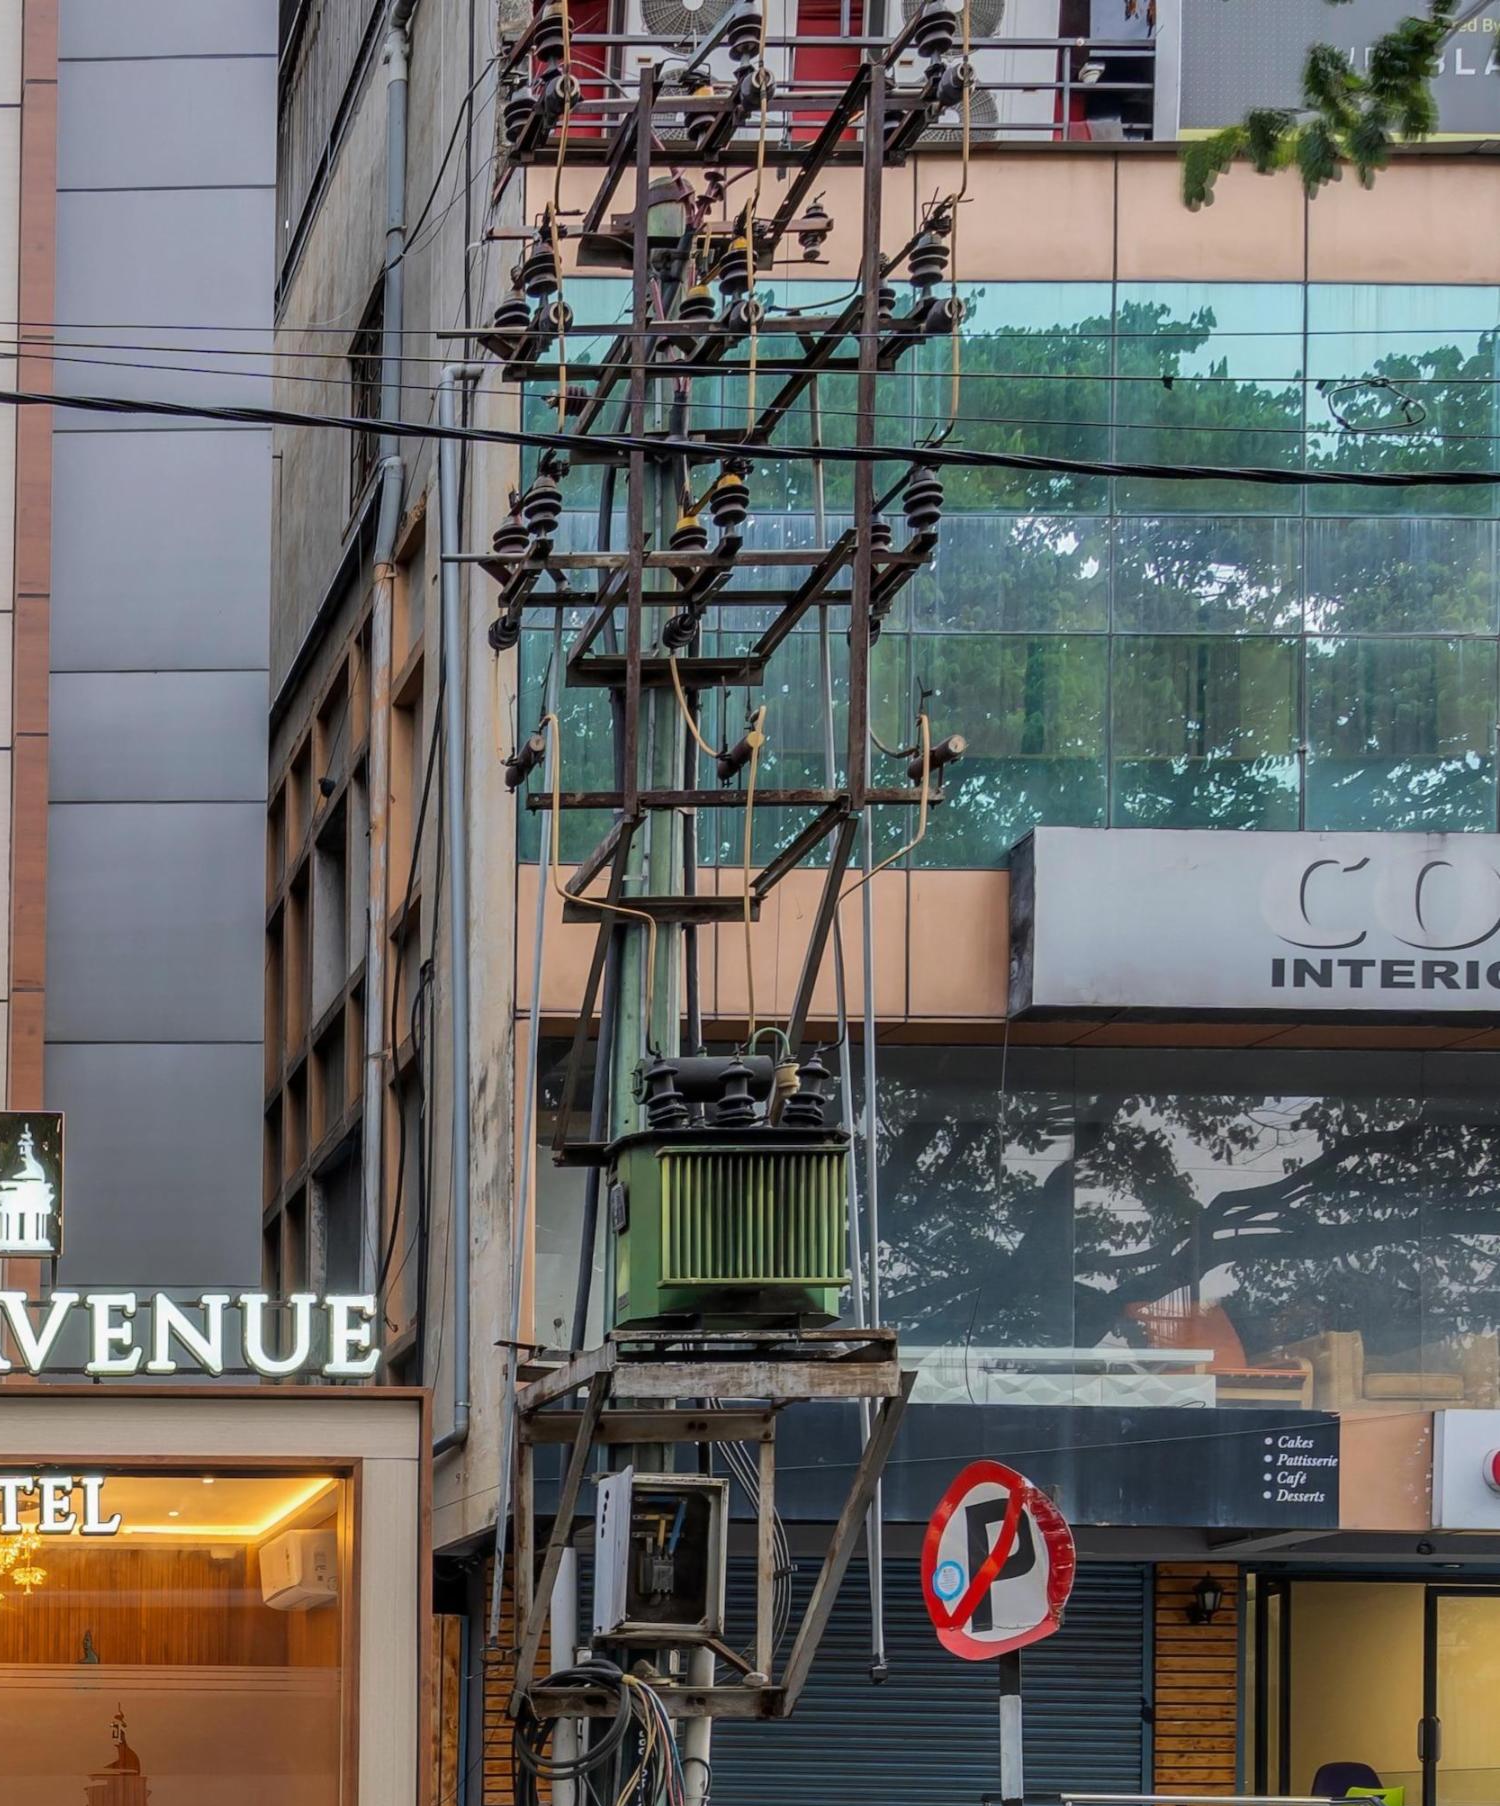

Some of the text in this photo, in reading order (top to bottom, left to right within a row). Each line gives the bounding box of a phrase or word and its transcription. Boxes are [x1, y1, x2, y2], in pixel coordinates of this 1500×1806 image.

[1278, 1435, 1314, 1448] Cakes
[1276, 1453, 1338, 1467] Pattisserie
[1277, 1471, 1307, 1488] Café
[1276, 1489, 1325, 1502] Desserts
